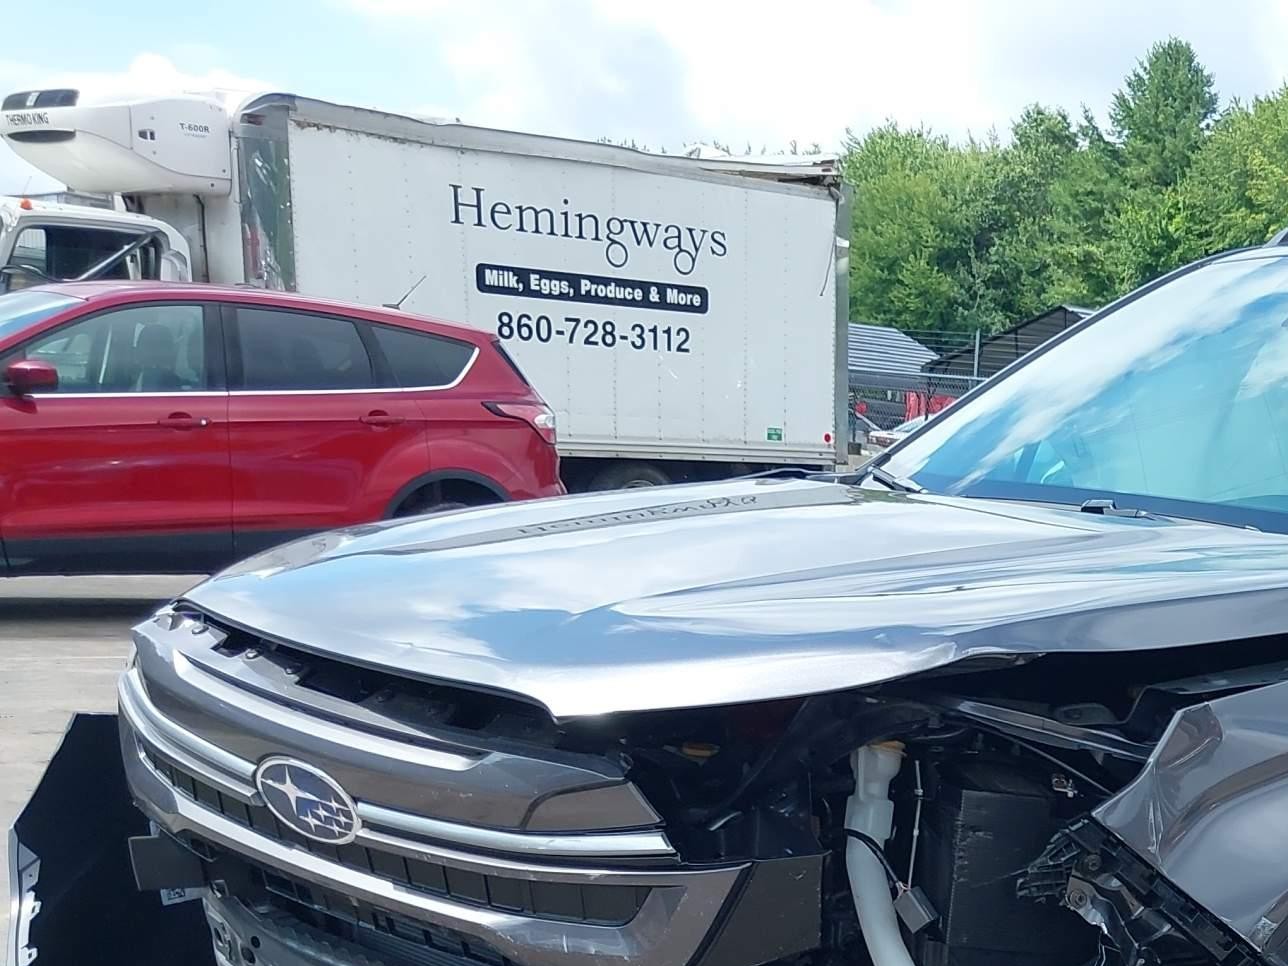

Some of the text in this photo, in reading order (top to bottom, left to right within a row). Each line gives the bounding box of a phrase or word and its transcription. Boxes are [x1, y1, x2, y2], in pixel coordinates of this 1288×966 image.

[6, 112, 49, 127] THERMO KING
[179, 122, 210, 133] T-600R
[449, 184, 727, 275] Hemingways
[484, 268, 702, 306] Milk, Eggs, Produce & More
[497, 311, 692, 353] 860-728-3112
